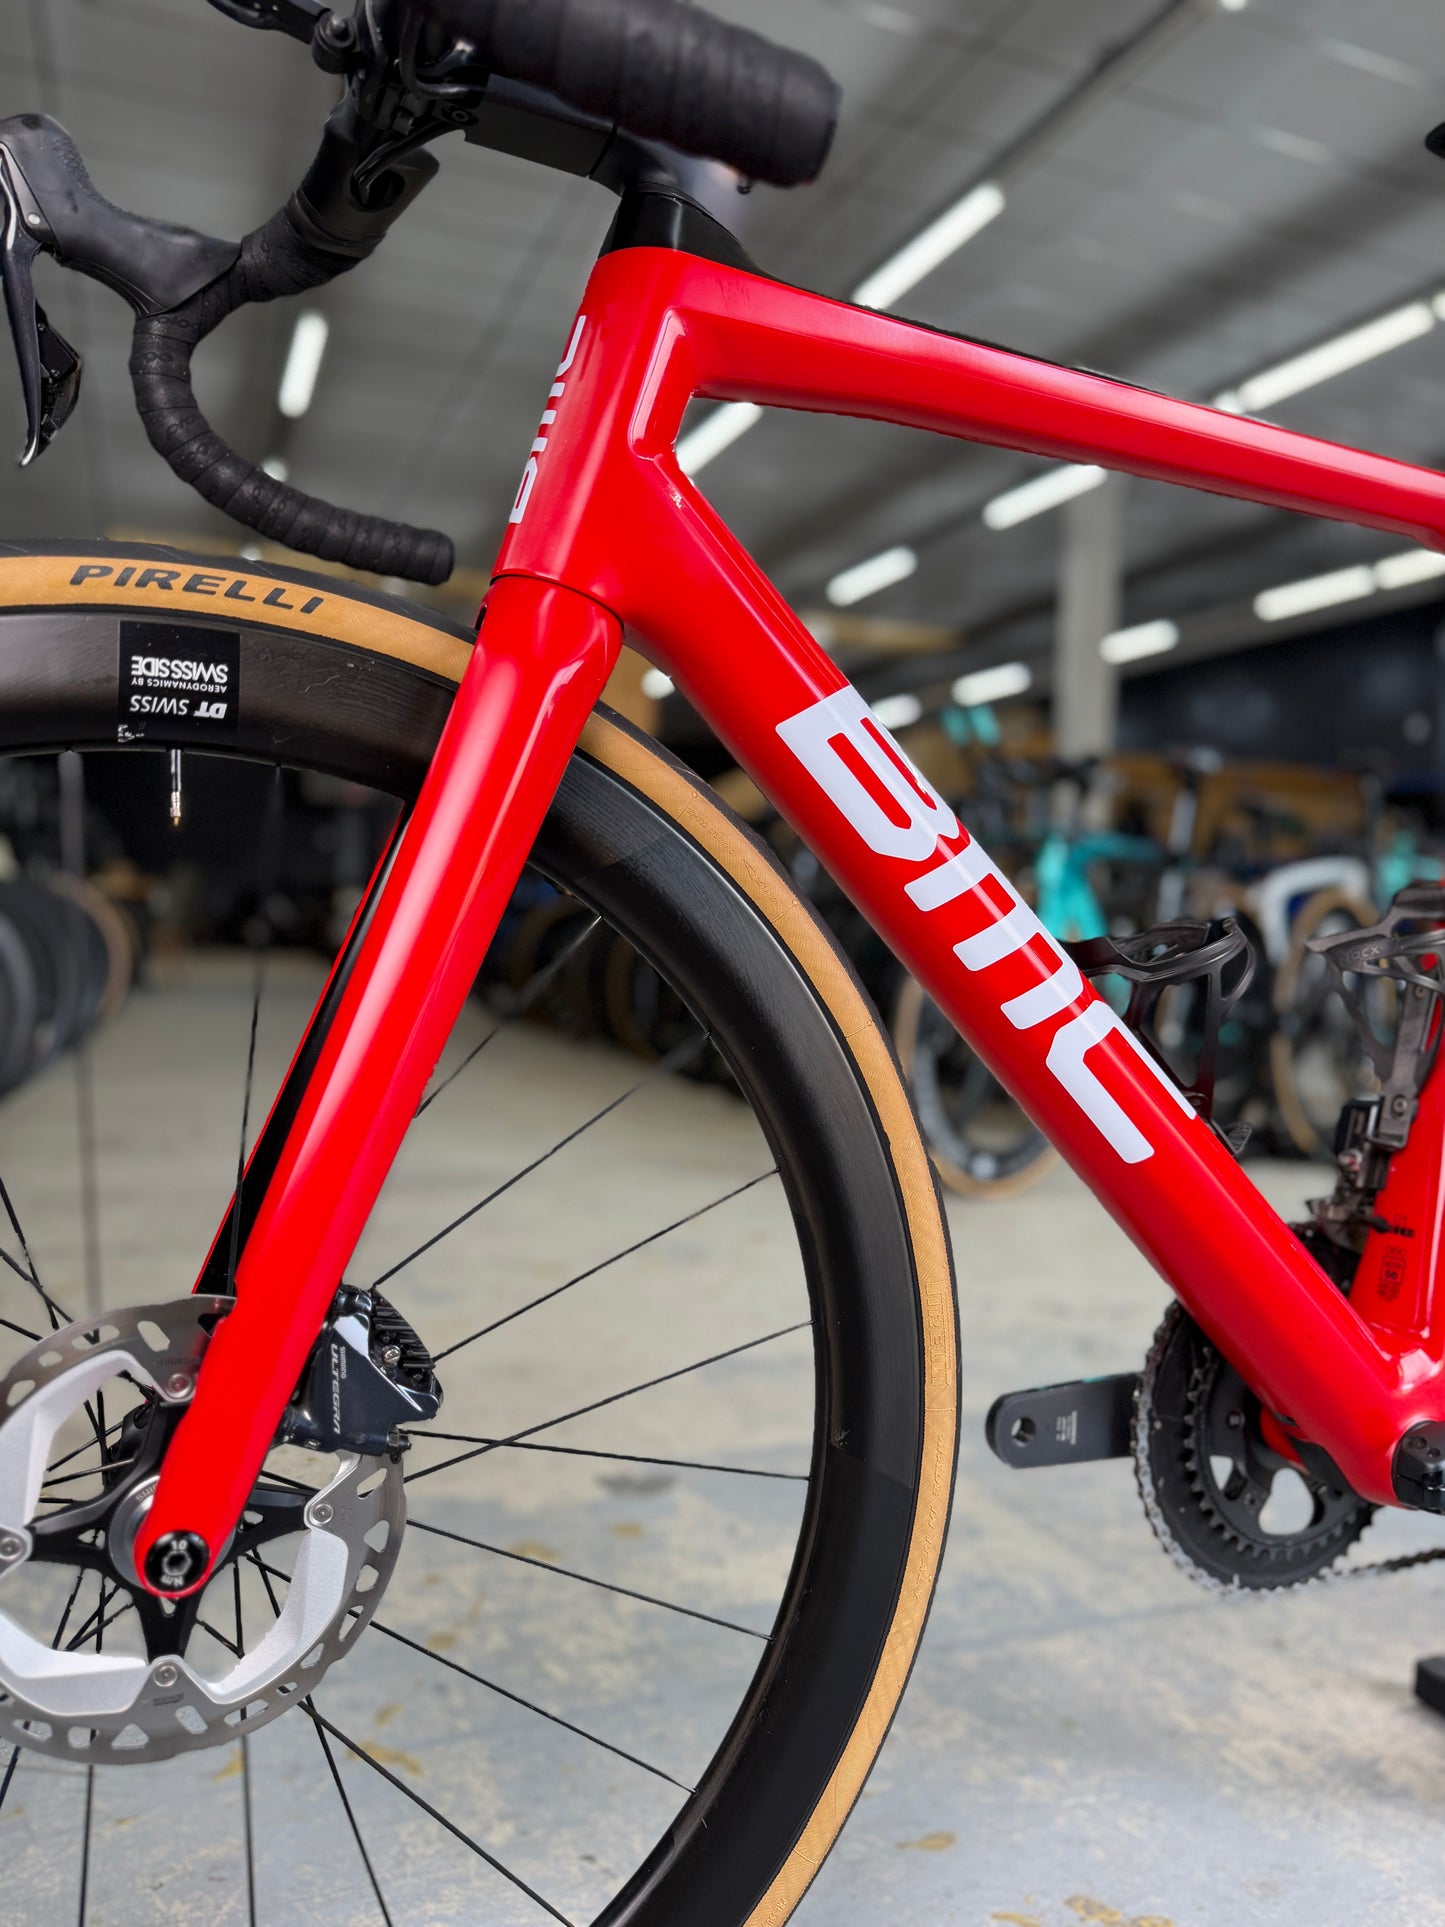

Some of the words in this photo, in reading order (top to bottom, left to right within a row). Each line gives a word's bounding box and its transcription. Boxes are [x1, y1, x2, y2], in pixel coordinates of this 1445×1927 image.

[69, 564, 325, 615] PIRELLI
[131, 678, 144, 687] BY
[147, 678, 228, 694] AERODYNAMICS
[129, 695, 190, 716] SWISS
[193, 702, 228, 719] DT
[775, 684, 1197, 1164] BMC
[331, 1343, 341, 1435] ULTEGRA
[171, 1540, 188, 1550] 10
[762, 1896, 789, 1927] PRESSU
